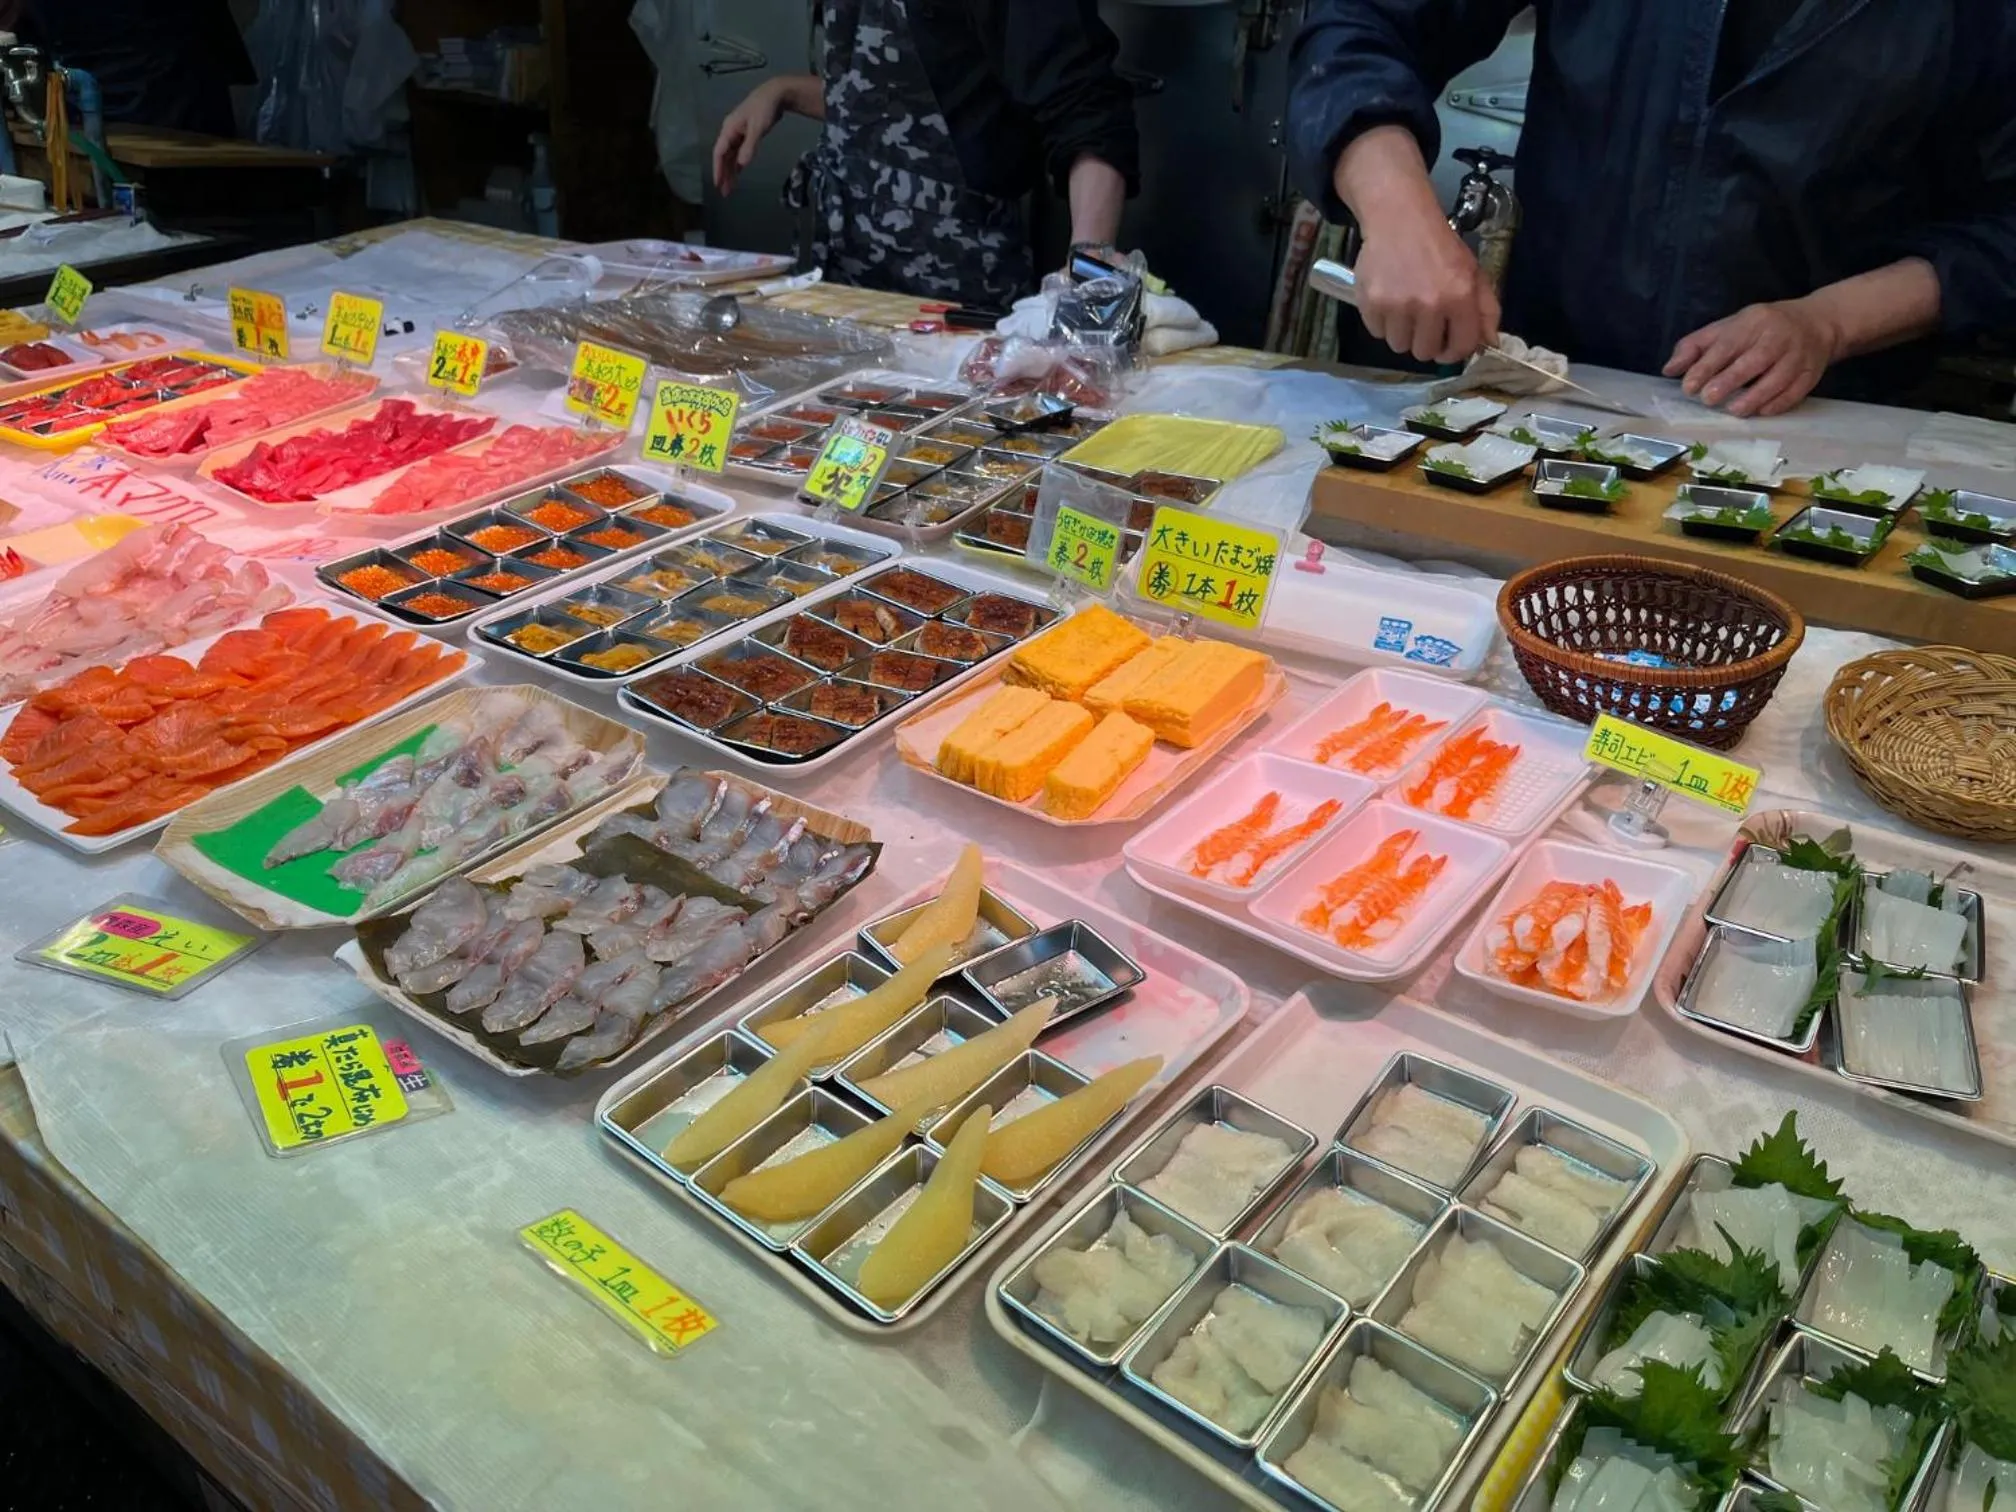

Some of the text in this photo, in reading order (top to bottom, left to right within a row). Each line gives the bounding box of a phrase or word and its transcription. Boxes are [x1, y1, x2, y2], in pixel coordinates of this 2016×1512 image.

[665, 408, 712, 436] いくら
[1591, 727, 1656, 767] 寿司エビ
[537, 1217, 606, 1264] 数の子
[641, 1296, 707, 1345] 1枚
